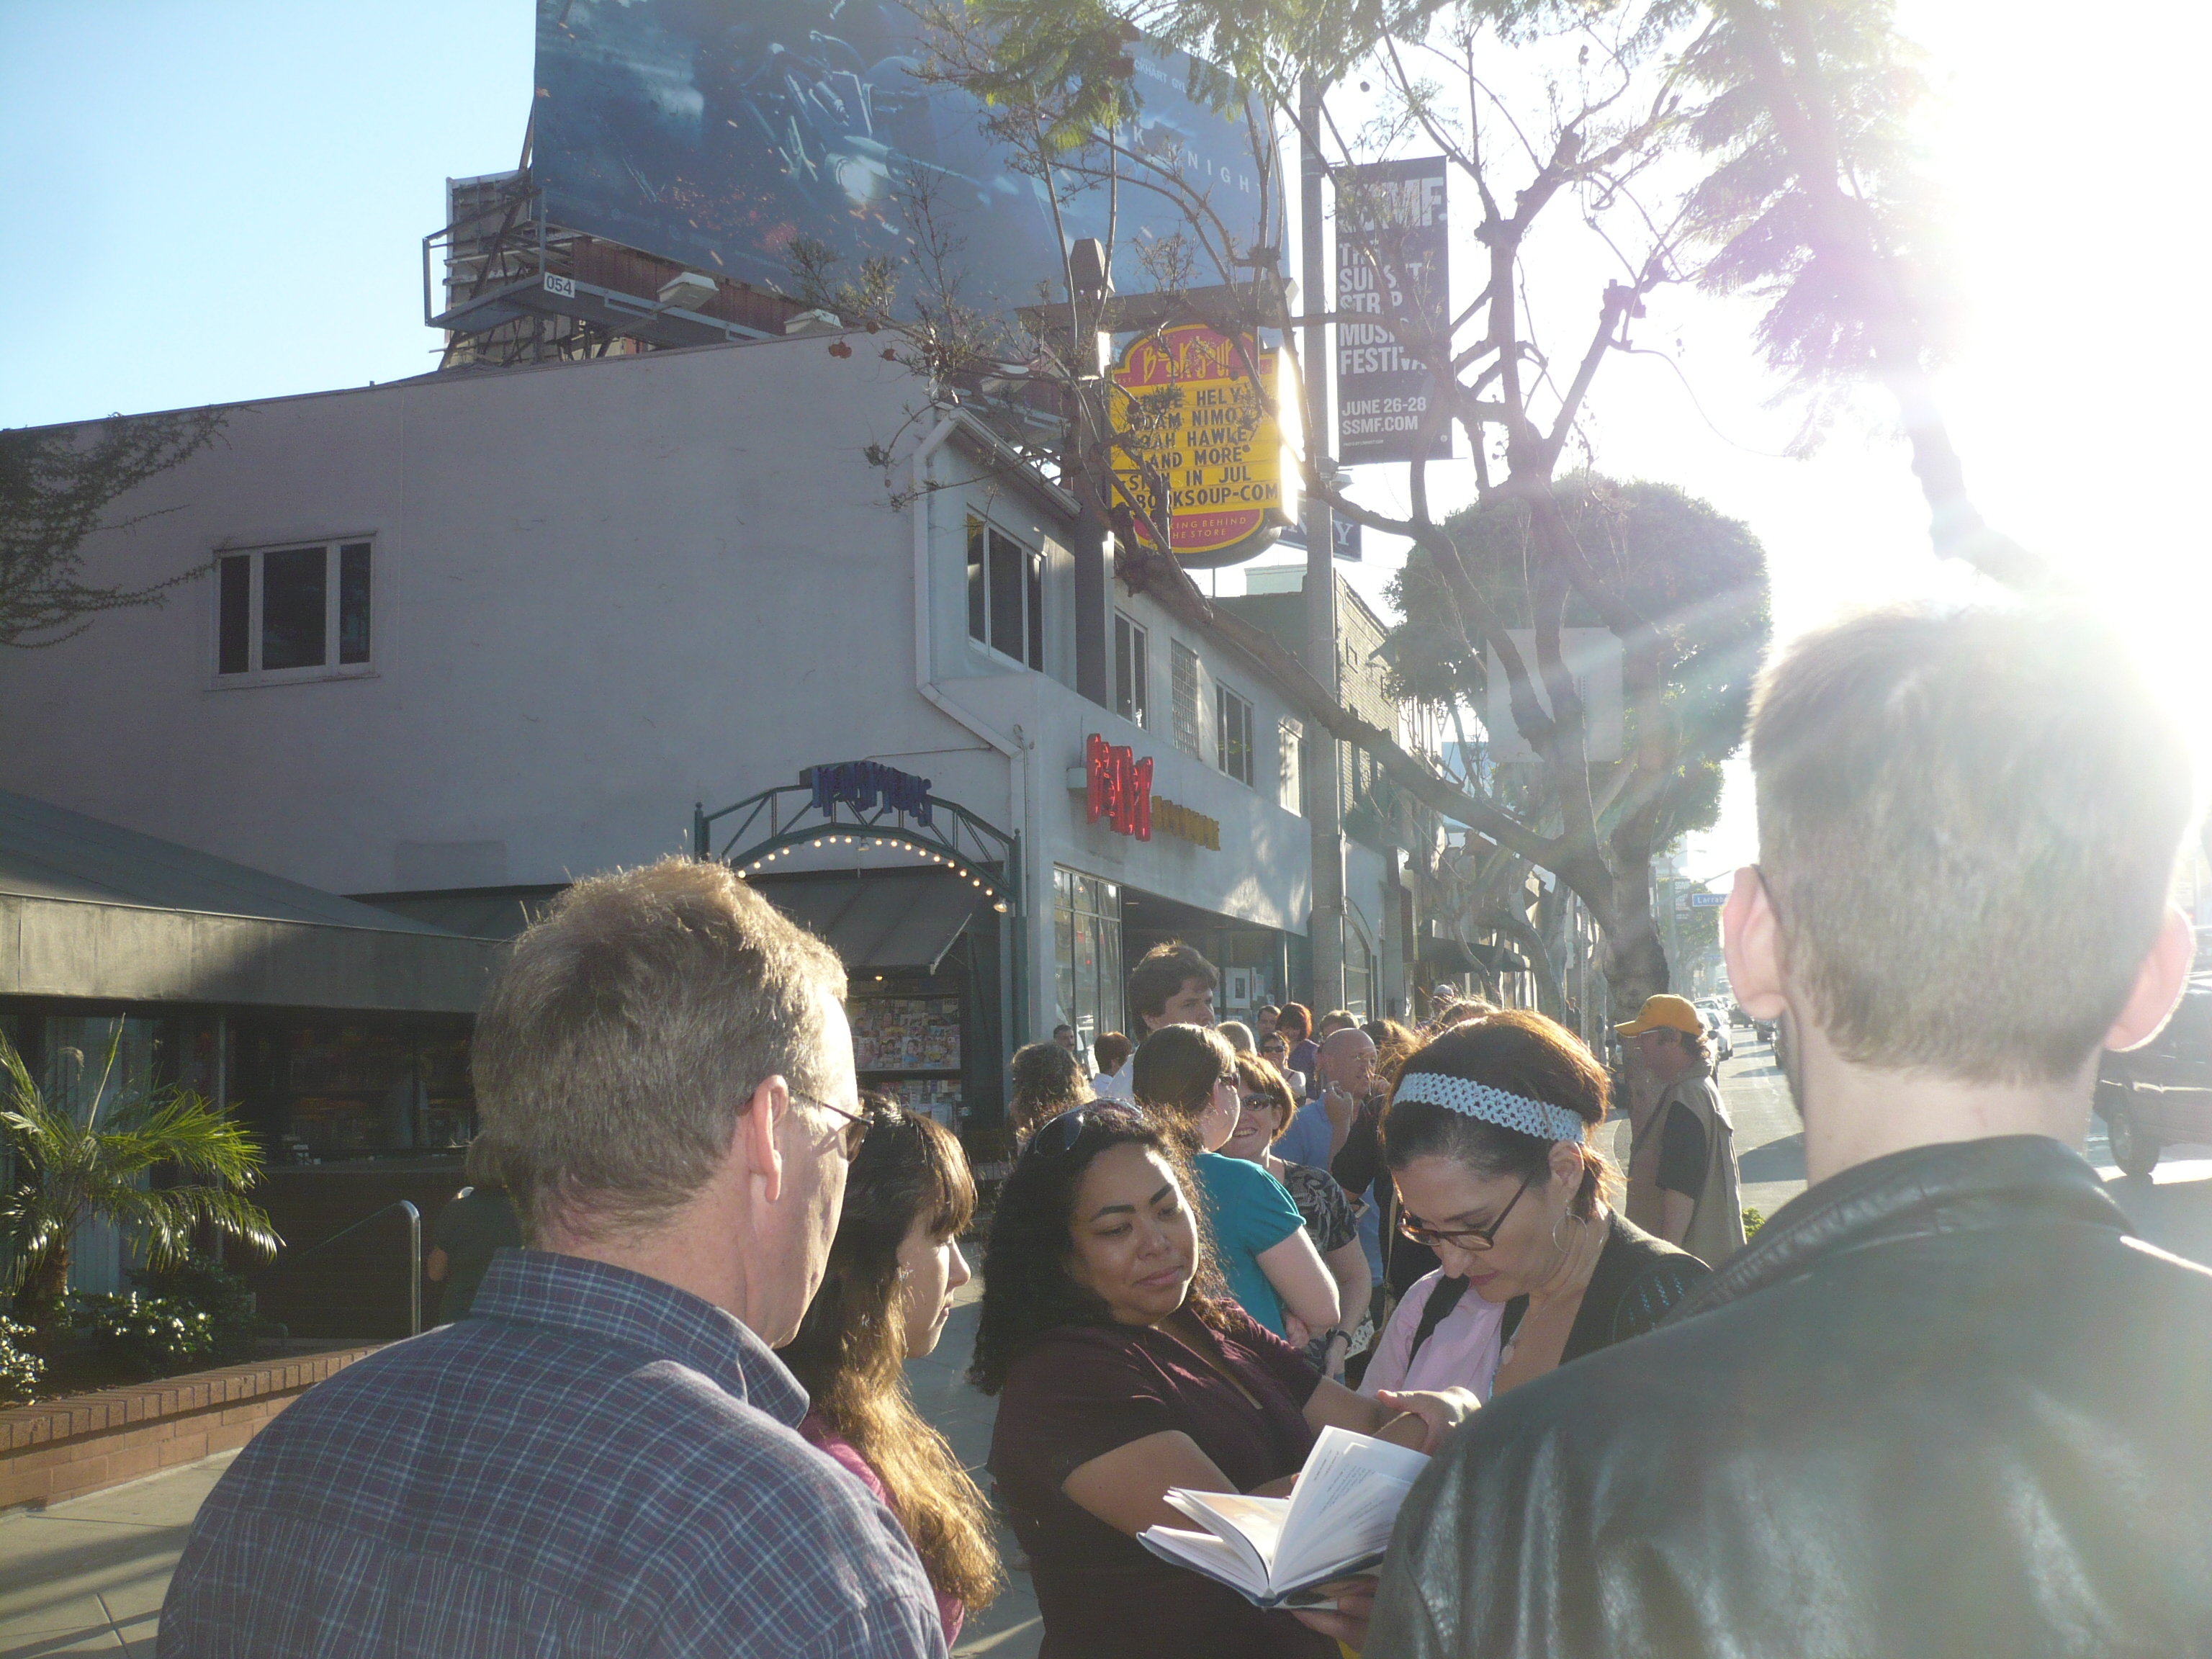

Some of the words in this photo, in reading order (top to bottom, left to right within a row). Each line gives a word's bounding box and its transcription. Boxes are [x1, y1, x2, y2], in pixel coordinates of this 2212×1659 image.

[1133, 59, 1167, 84] CKHART
[1169, 145, 1261, 194] KNIGH
[547, 275, 572, 295] 054
[1340, 291, 1403, 314] STRP
[1197, 387, 1241, 407] HELY
[1342, 399, 1381, 416] JUNE
[1383, 396, 1427, 413] 26-28
[1137, 412, 1182, 431] DAM
[1192, 407, 1244, 426] NIMO
[1342, 415, 1419, 435] SSMF.COM
[1137, 432, 1176, 449] OAH
[1151, 451, 1183, 469] AND
[1194, 446, 1243, 466] MORE
[1186, 469, 1202, 486] IN
[1219, 466, 1251, 483] JUL
[1136, 483, 1278, 508] BOKSOUP-COM
[1202, 517, 1247, 526] BEHIND
[1190, 529, 1226, 538] STORE
